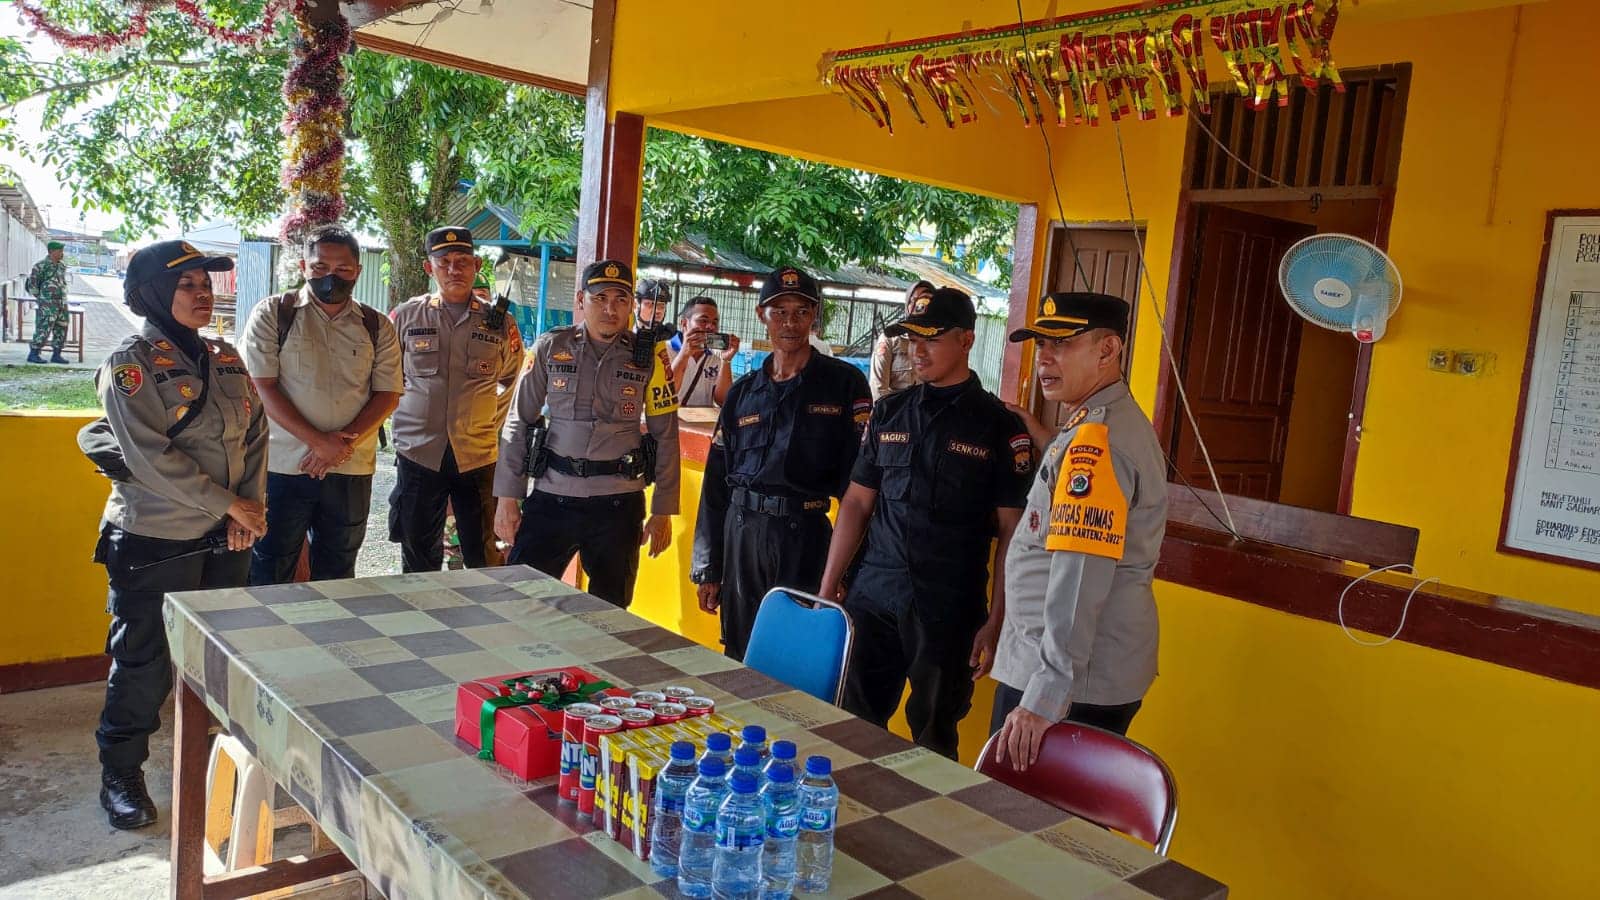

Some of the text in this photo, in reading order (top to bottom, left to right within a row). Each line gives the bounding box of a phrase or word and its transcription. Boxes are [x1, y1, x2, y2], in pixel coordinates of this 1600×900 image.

[616, 370, 645, 382] POLRI
[950, 442, 986, 458] SENKOM
[1071, 446, 1100, 454] POLDA
[1083, 506, 1114, 531] HUMAS
